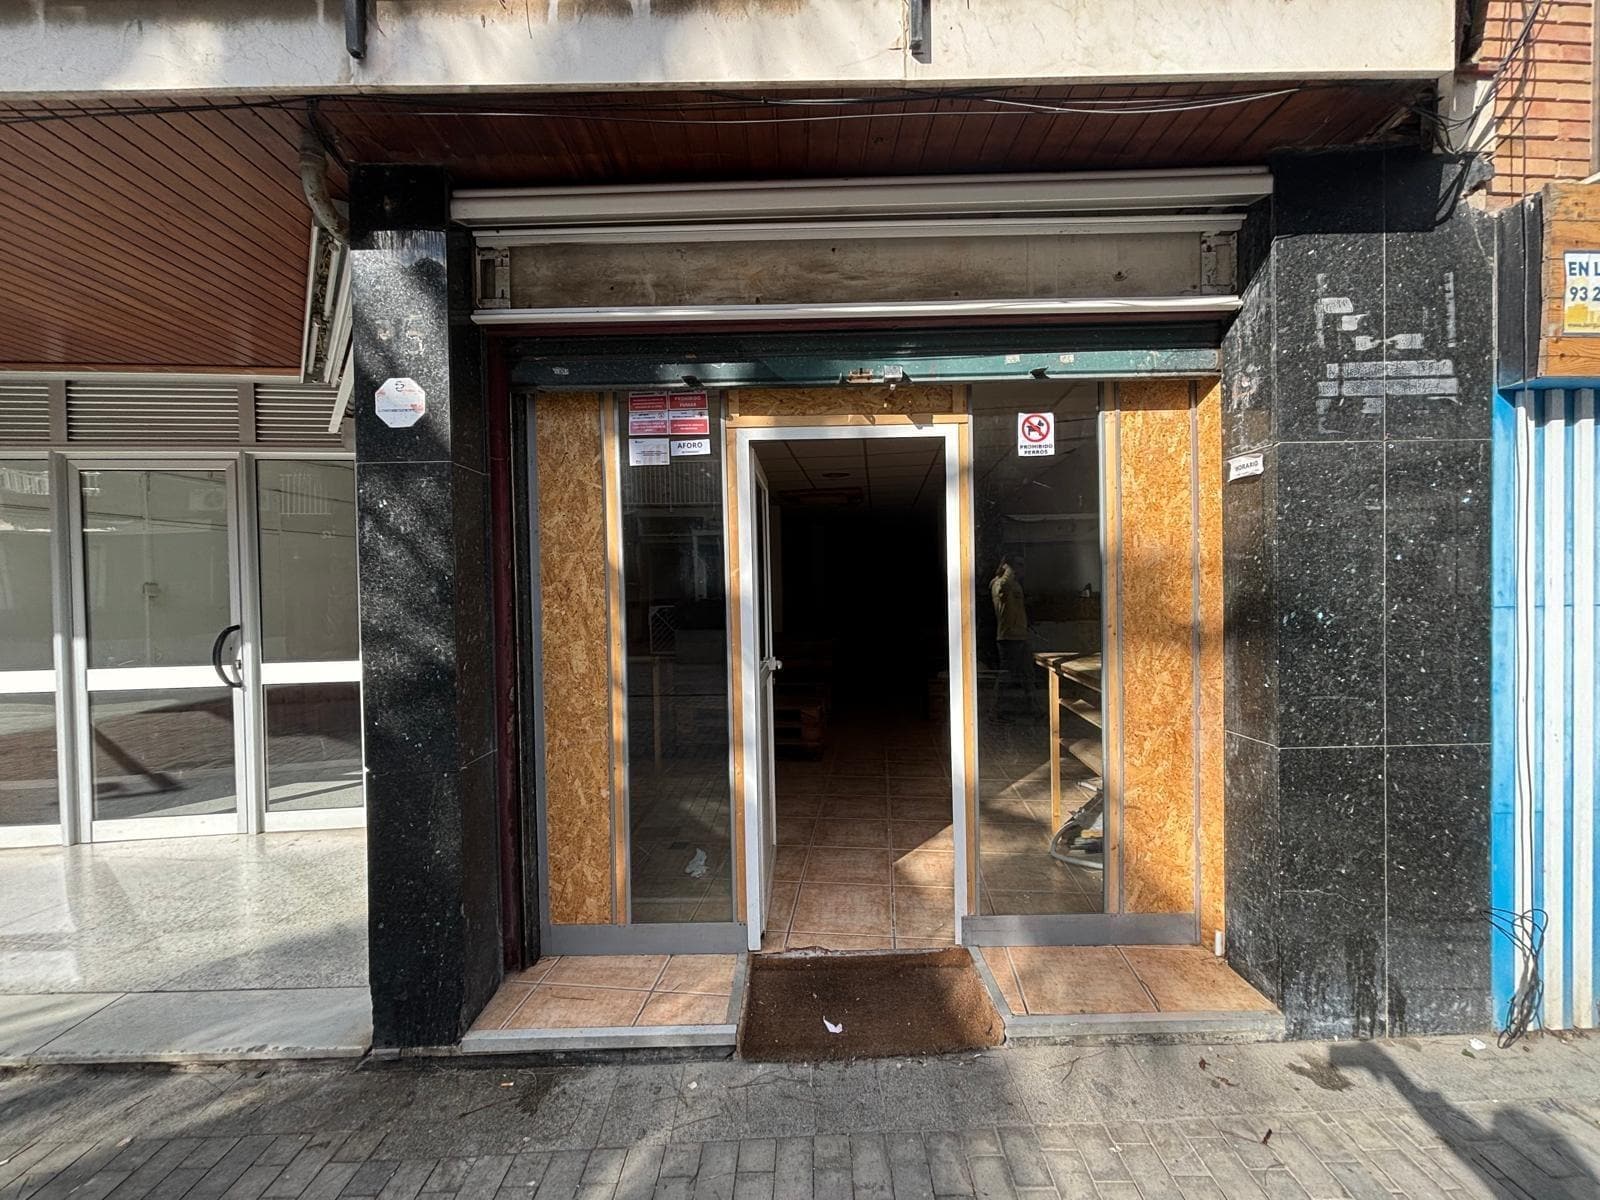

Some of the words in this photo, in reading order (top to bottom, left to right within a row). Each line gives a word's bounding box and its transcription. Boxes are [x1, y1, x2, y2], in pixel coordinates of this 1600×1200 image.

[1568, 261, 1589, 276] EN
[1570, 286, 1588, 302] 93
[1235, 460, 1259, 472] HORARIO
